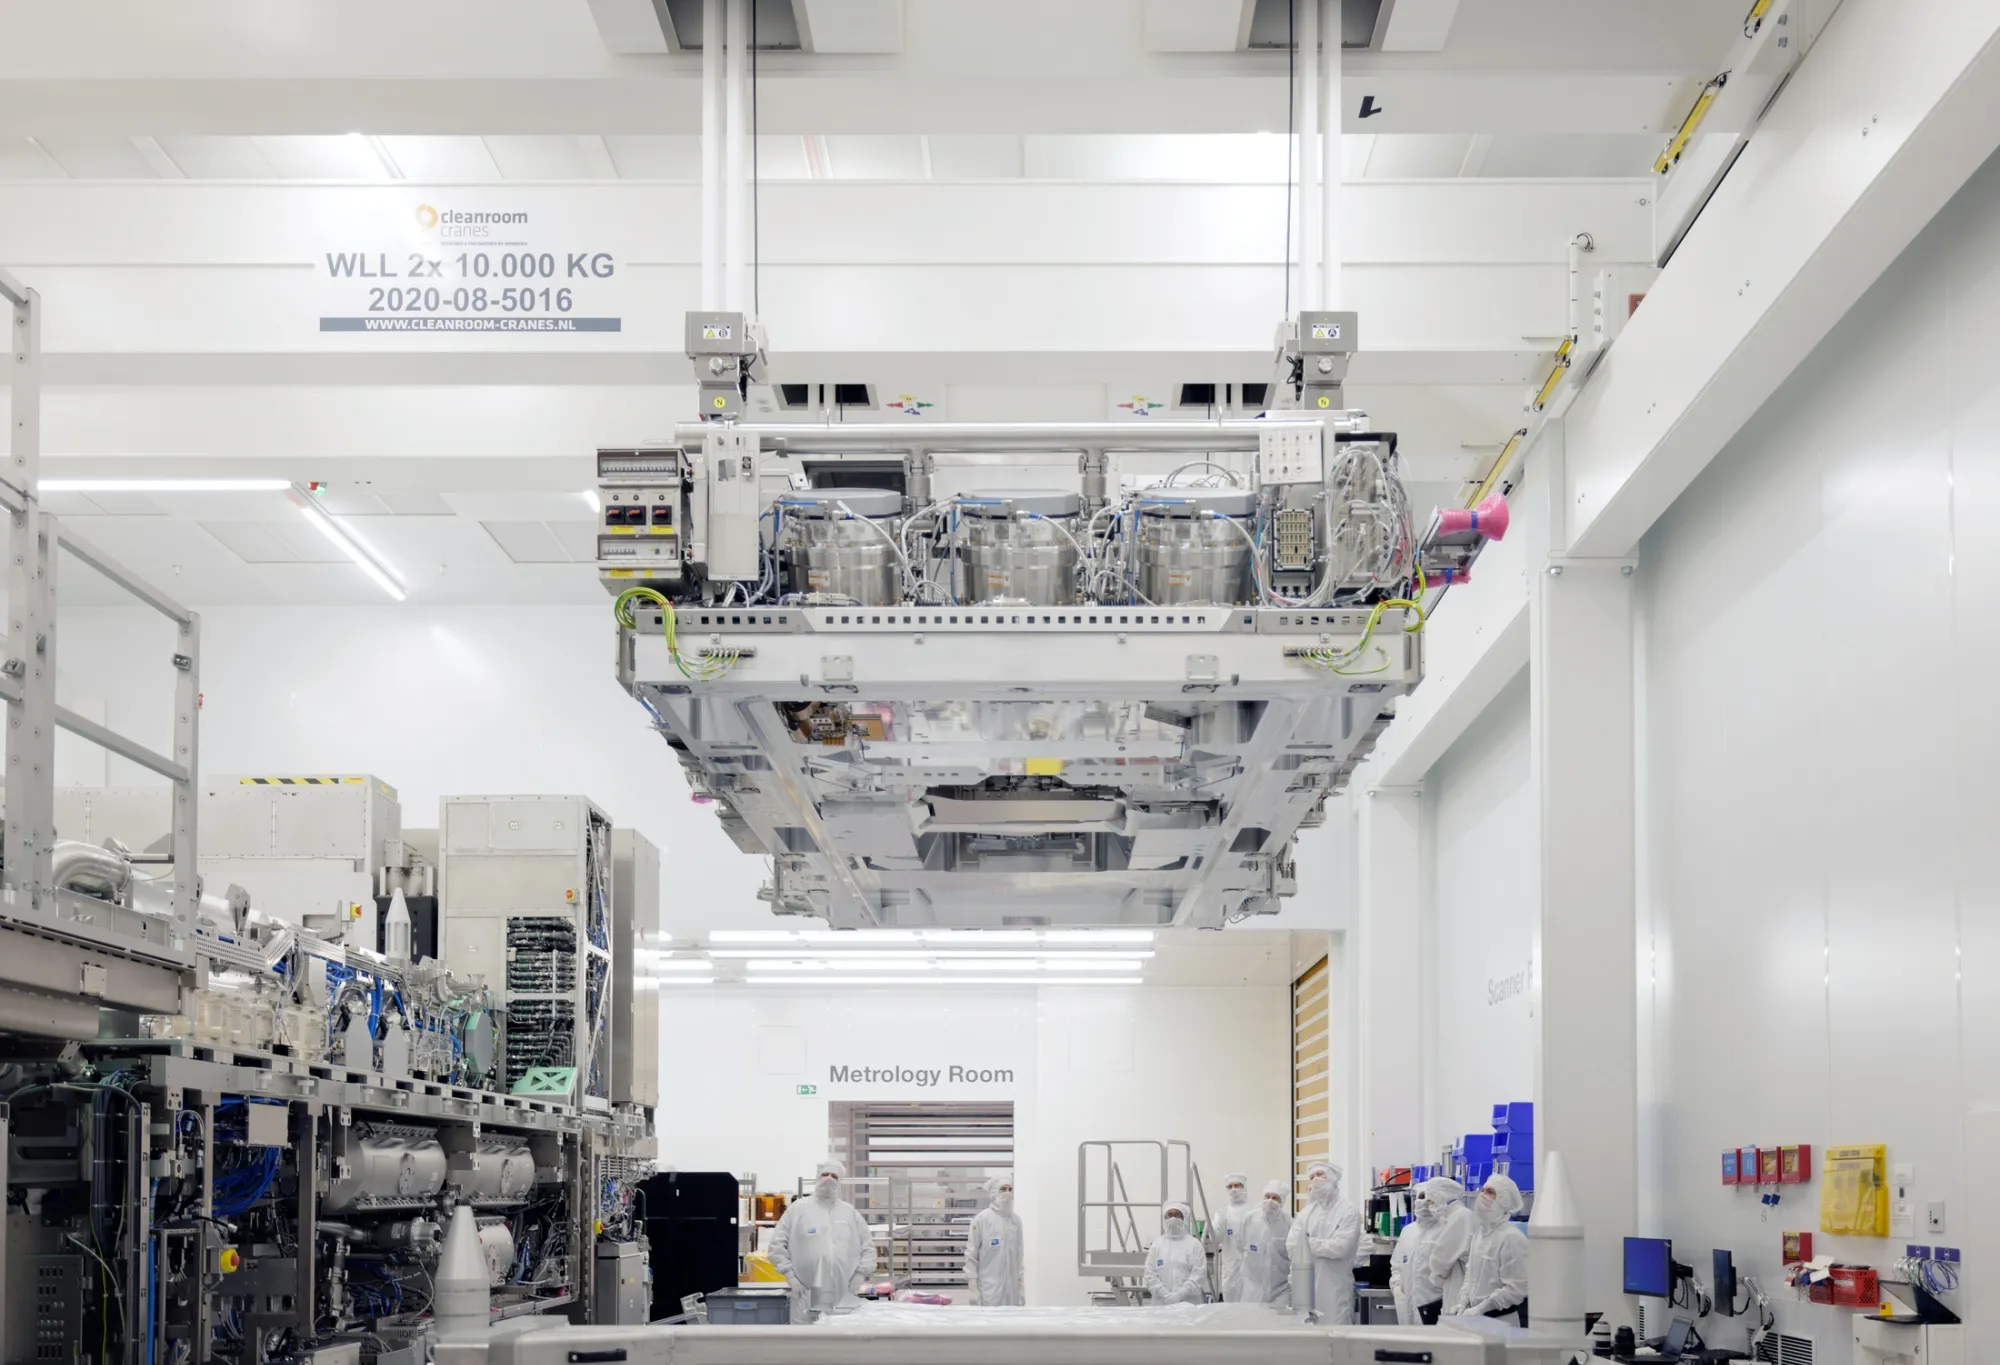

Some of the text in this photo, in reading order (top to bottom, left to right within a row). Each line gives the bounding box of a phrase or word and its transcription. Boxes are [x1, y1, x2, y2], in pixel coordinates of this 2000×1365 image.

[441, 209, 529, 224] cleanroom
[440, 225, 489, 238] cranes
[326, 253, 615, 278] WLL 2x 10.000 KG
[368, 287, 573, 312] 2020-08-5016
[365, 318, 576, 331] WWW.CLEANROOM-CRANES.NL
[1487, 970, 1525, 1006] Scanner
[829, 1065, 1014, 1087] Metrology Room
